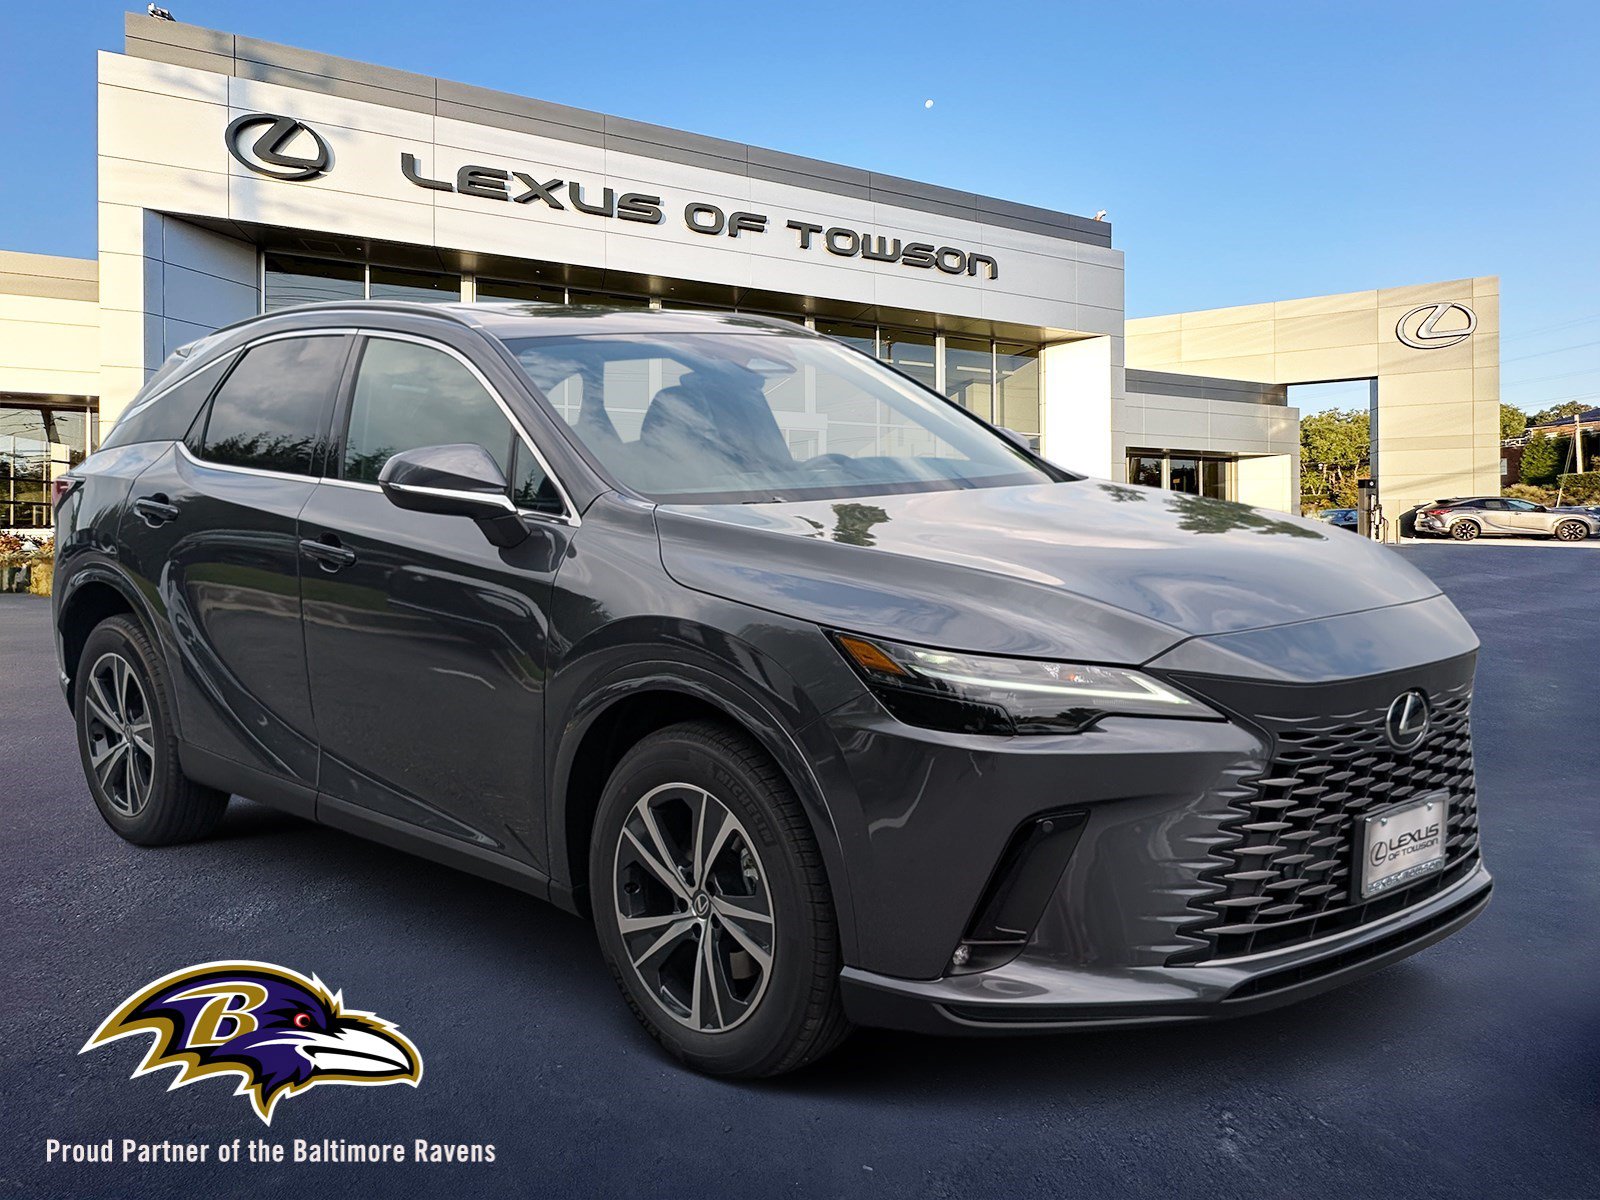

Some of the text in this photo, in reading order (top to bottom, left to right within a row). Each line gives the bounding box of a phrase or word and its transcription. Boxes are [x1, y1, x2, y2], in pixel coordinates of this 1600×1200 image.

[401, 152, 998, 280] LEXUS OF TOWSON
[714, 769, 777, 848] MICHELIN
[1388, 823, 1439, 851] LEXUS
[1388, 838, 1438, 862] OF TOWSON
